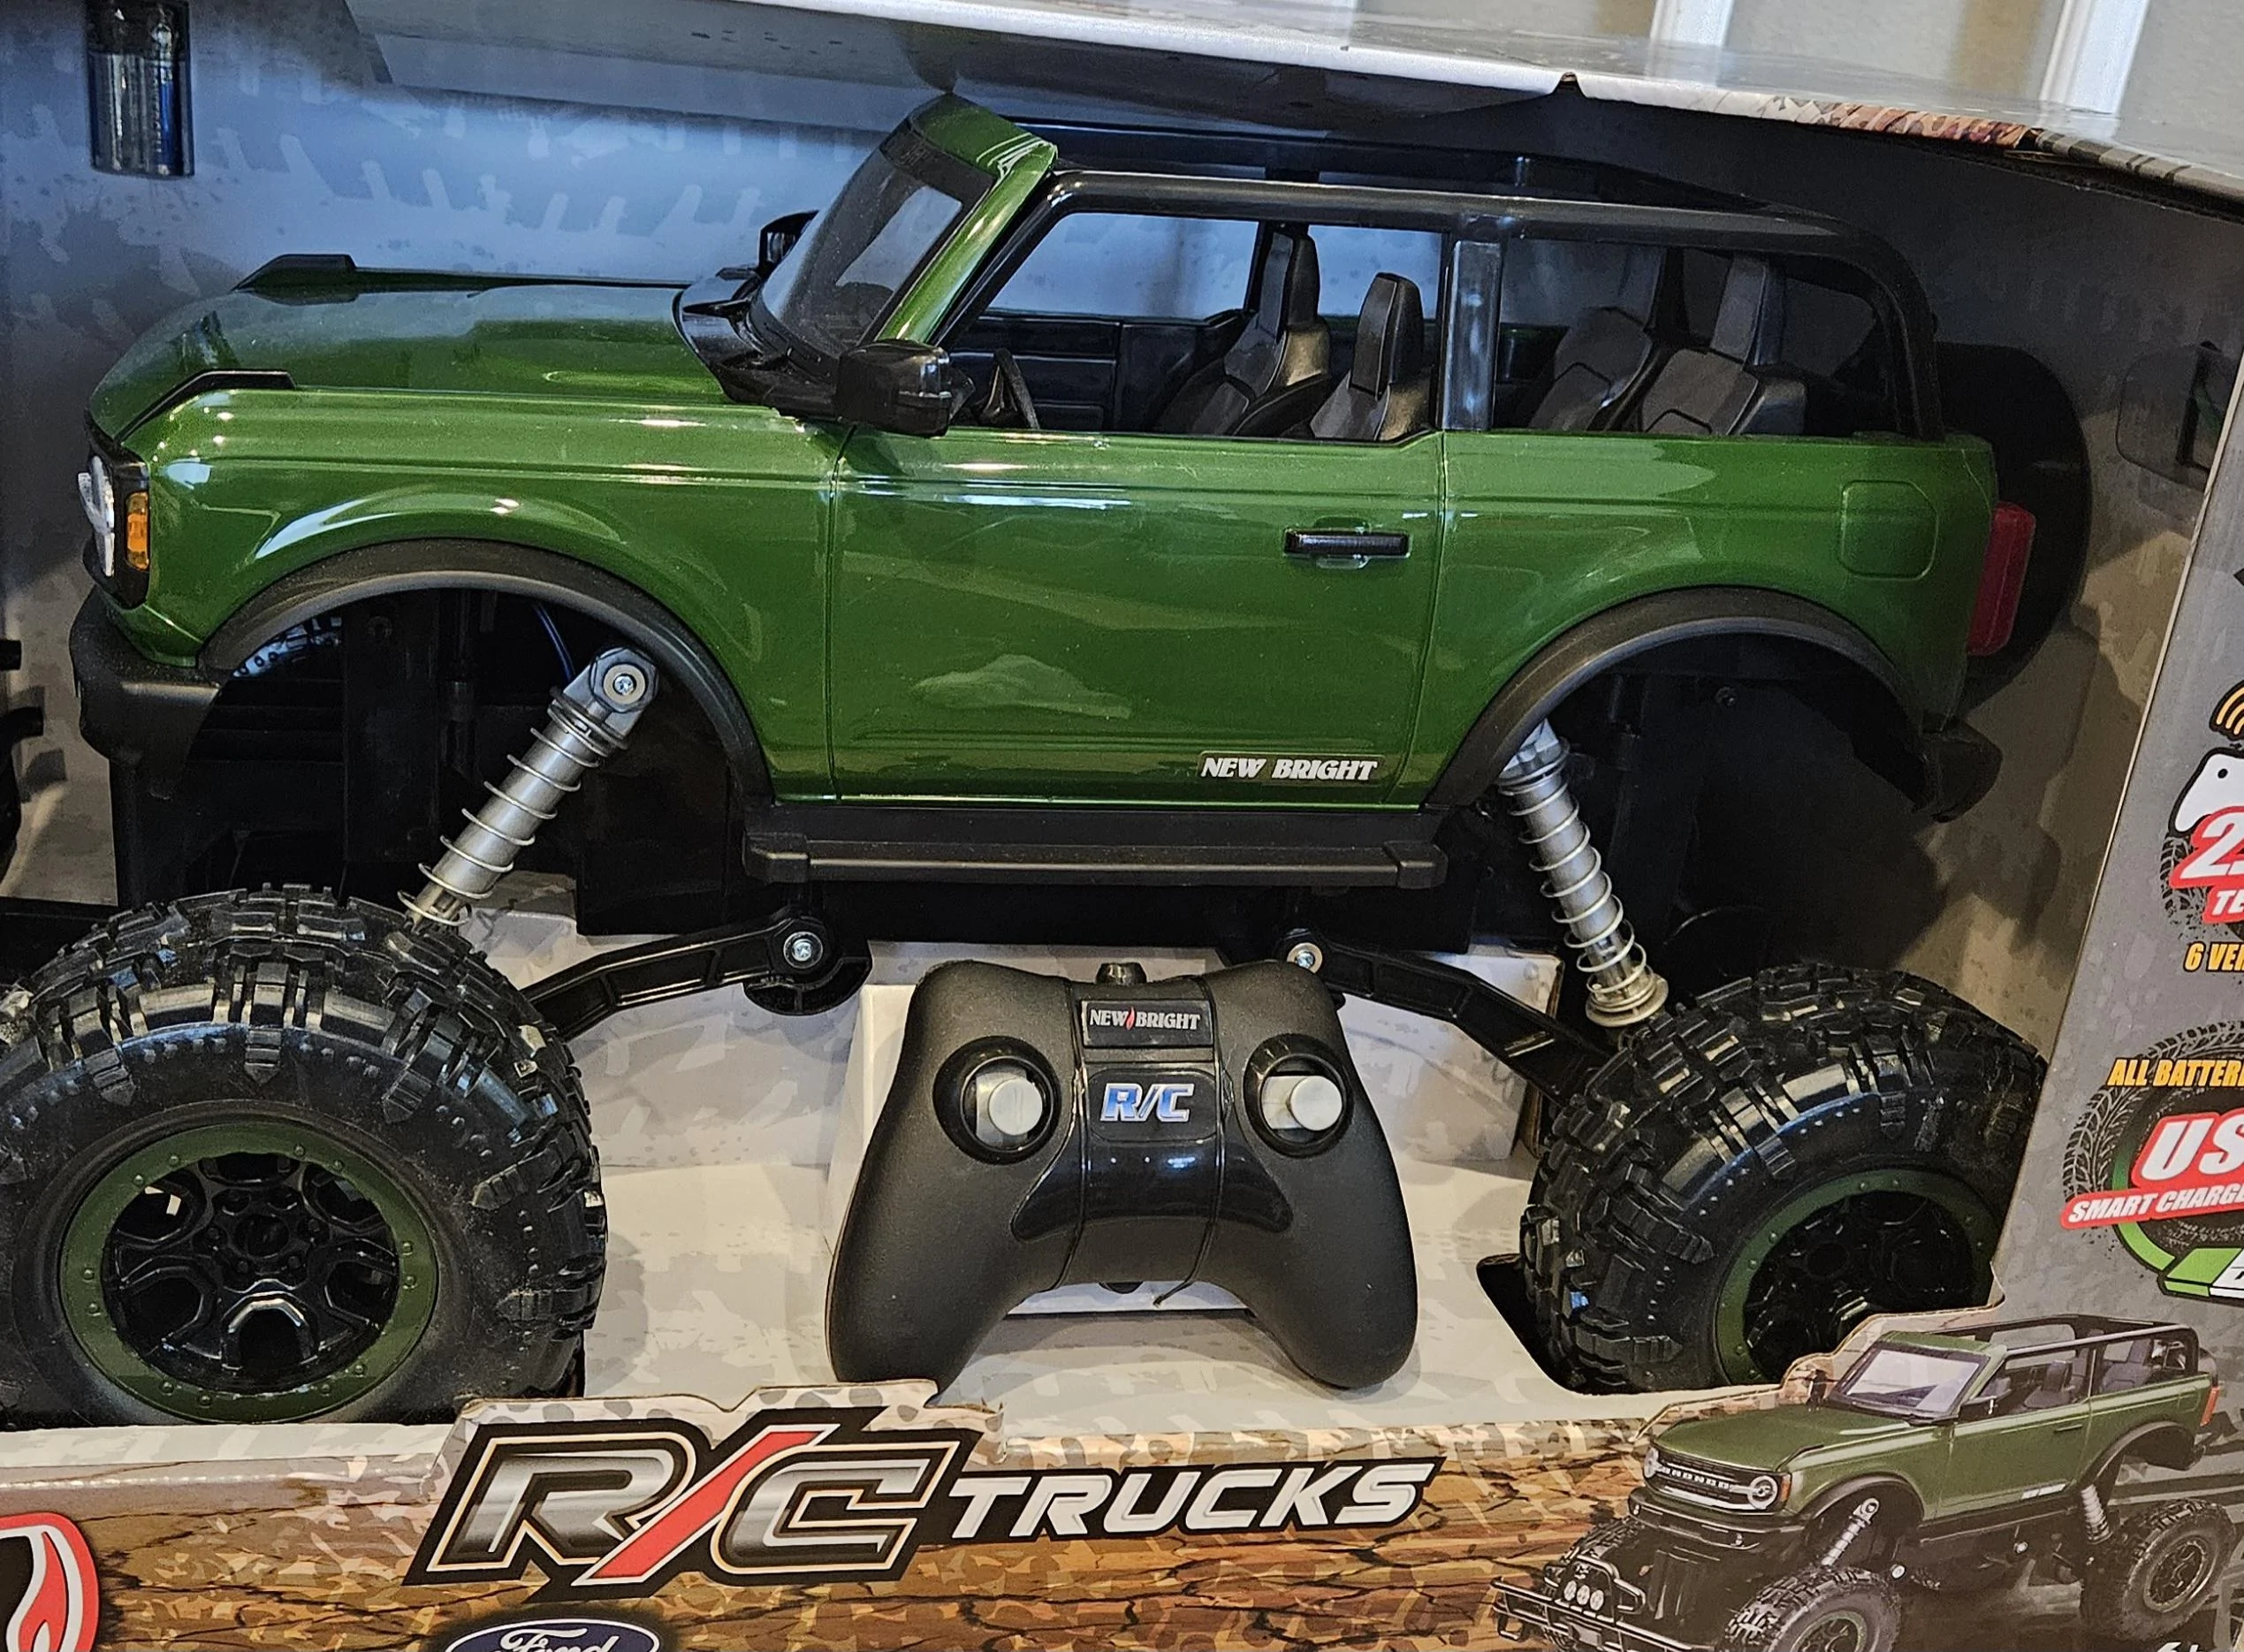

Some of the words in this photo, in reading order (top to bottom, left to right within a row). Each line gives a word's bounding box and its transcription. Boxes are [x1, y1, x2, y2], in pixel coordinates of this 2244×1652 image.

[1200, 757, 1267, 779] NEW
[1271, 758, 1379, 782] BRIGHT
[2184, 942, 2205, 971] 6
[1089, 1009, 1129, 1027] NEW
[1134, 1012, 1201, 1031] BRIGHT
[2107, 1058, 2151, 1086] ALL
[1099, 1083, 1196, 1123] R/C
[2068, 1193, 2159, 1223] SMART
[426, 1423, 960, 1587] R/C
[948, 1463, 1436, 1539] TRUCKS
